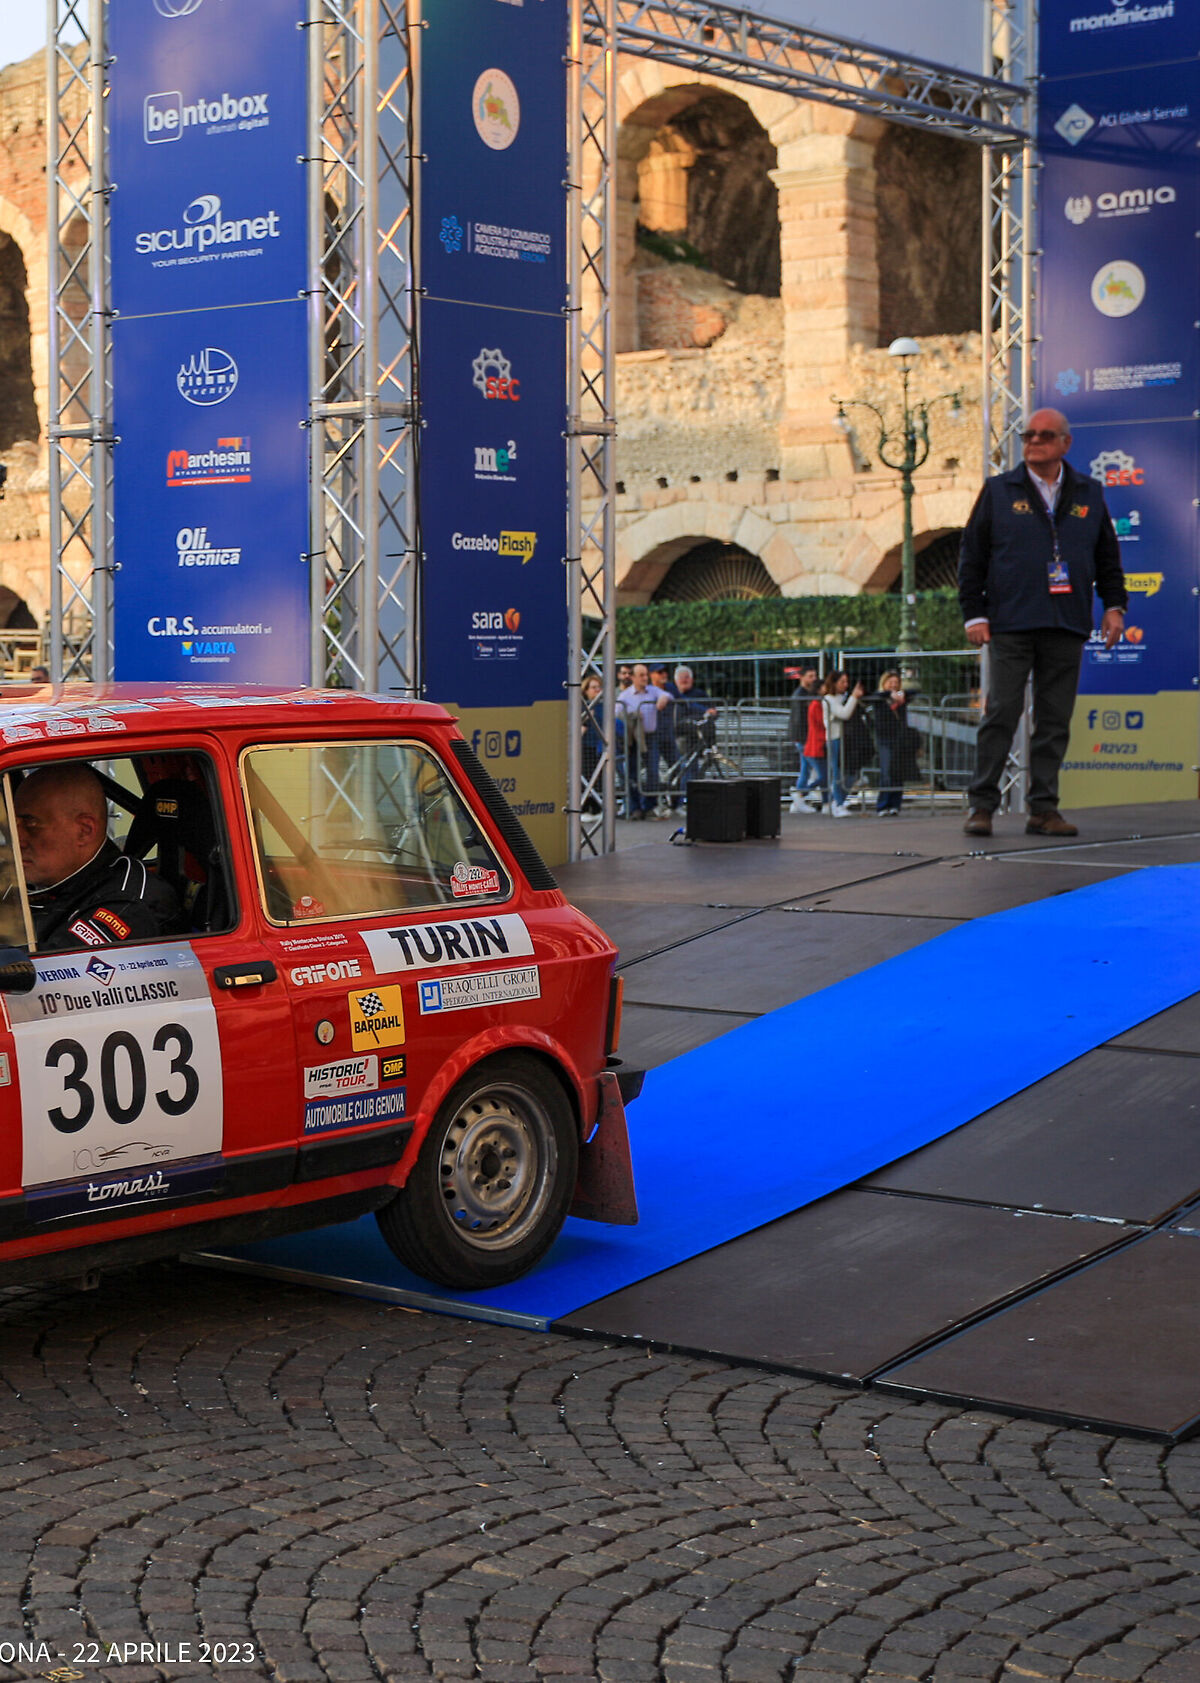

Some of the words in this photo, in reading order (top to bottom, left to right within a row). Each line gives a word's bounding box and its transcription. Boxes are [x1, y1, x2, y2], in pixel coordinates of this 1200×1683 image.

[1069, 0, 1175, 33] mondinicavi
[147, 92, 269, 133] bentobox
[1097, 186, 1176, 211] amia
[135, 210, 280, 254] sicurplanet
[151, 258, 177, 268] YOUR
[177, 253, 220, 266] SECURITY
[221, 248, 263, 261] PARTNER
[485, 376, 520, 401] SEC
[167, 449, 251, 478] Marchesini
[1105, 467, 1145, 487] SEC
[177, 548, 242, 567] Tecnica
[147, 616, 199, 637] C.R.S.
[201, 623, 262, 636] accumulatori
[471, 611, 504, 630] sara
[195, 641, 238, 655] VARTA
[387, 918, 510, 966] TURIN
[37, 967, 81, 983] VERONA
[441, 975, 499, 995] FRAQUELLI
[503, 970, 537, 986] GROUP
[38, 992, 61, 1015] 10°
[63, 993, 92, 1011] Due
[92, 985, 124, 1007] Valli
[125, 980, 179, 1003] CLASSIC
[442, 993, 479, 1006] SPEDIZIONI
[482, 985, 538, 1001] INTERNAZIONALI
[353, 1015, 402, 1034] BARDAHL
[44, 1022, 200, 1134] 303
[308, 1061, 365, 1083] HISTORIC
[383, 1062, 404, 1074] OMP
[335, 1074, 366, 1088] TOUR
[304, 1101, 354, 1129] AUTOMOBILE
[354, 1097, 375, 1120] CLUB
[375, 1092, 405, 1117] GENOVA
[86, 1170, 170, 1202] tomasi
